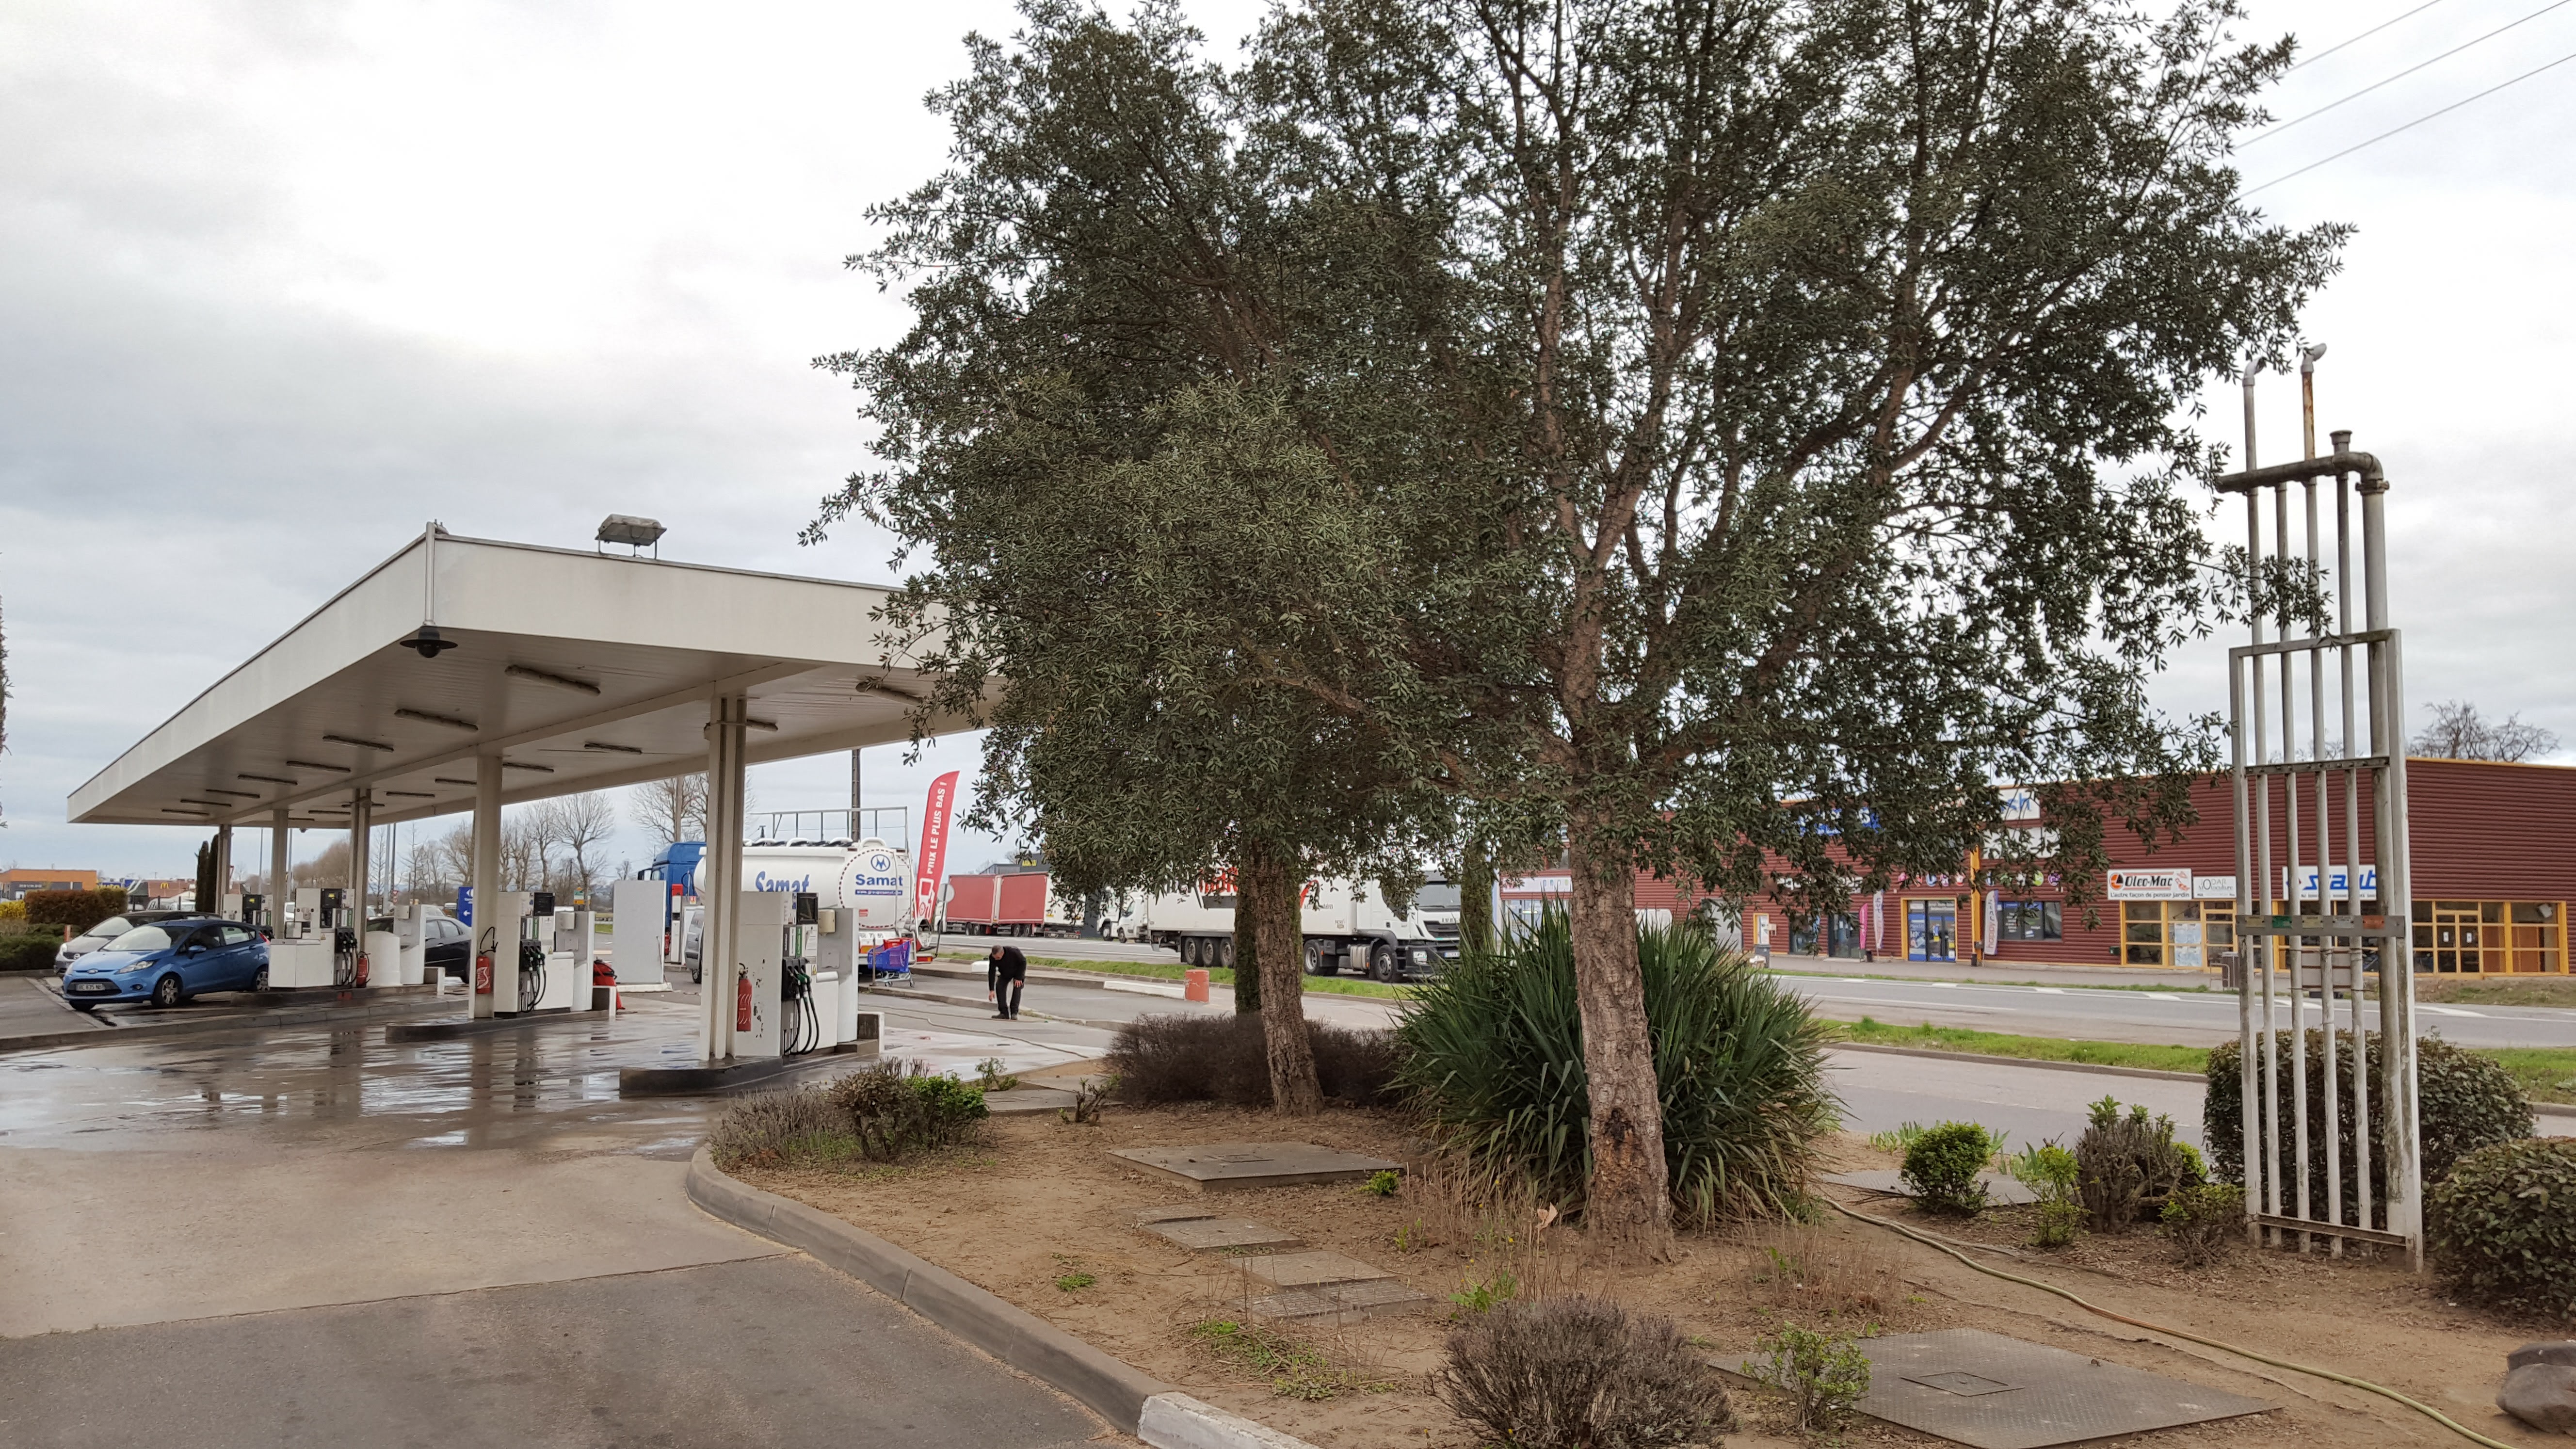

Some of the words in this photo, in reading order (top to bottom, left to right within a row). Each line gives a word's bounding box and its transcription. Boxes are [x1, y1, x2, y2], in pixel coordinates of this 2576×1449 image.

[935, 788, 946, 808] BAS
[932, 810, 942, 836] PLUS
[930, 837, 939, 849] LE
[927, 851, 937, 874] PRIX
[755, 870, 809, 892] Samat
[855, 873, 903, 886] Samat
[2125, 875, 2173, 886] Oleo-Mac
